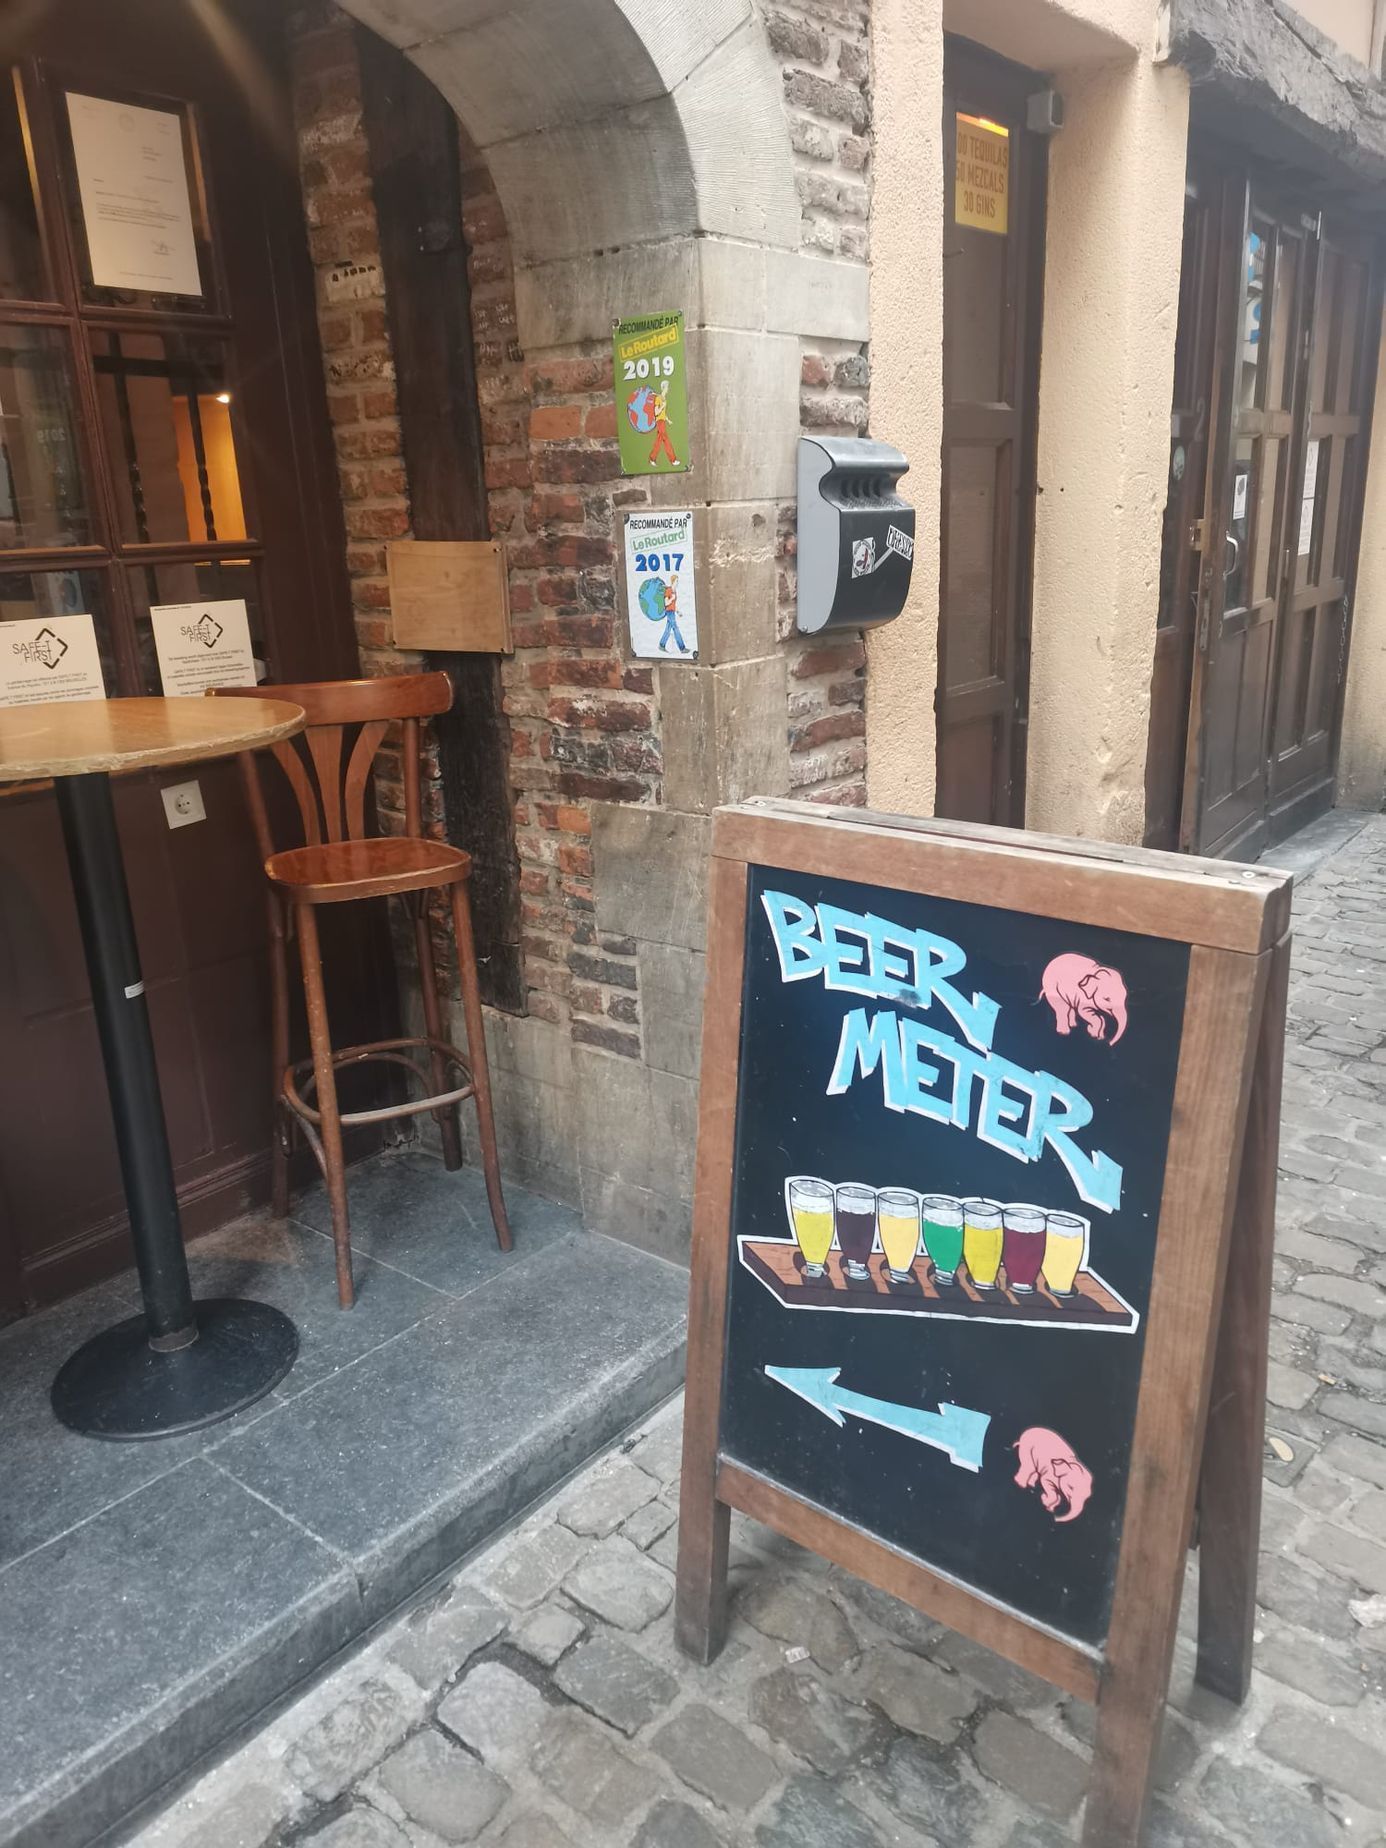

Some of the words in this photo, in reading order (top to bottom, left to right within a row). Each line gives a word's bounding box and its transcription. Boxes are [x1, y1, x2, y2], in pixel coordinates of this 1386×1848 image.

[970, 136, 1008, 168] TEQUILAS
[968, 164, 1004, 193] MEZCALS
[963, 190, 973, 213] 30
[976, 194, 996, 218] GINS
[619, 316, 664, 335] RECOMMANDÉ
[665, 316, 679, 327] PAR
[623, 356, 675, 380] 2019
[629, 517, 673, 530] RECOMMANDÉ
[674, 517, 687, 528] PAR
[635, 553, 684, 572] 2017
[180, 623, 210, 637] SAFE-T
[189, 631, 212, 642] FIRST
[12, 640, 51, 655] SAFE-T
[24, 649, 53, 663] FIRST
[761, 889, 1001, 1053] BEER
[826, 1007, 1123, 1213] METER
